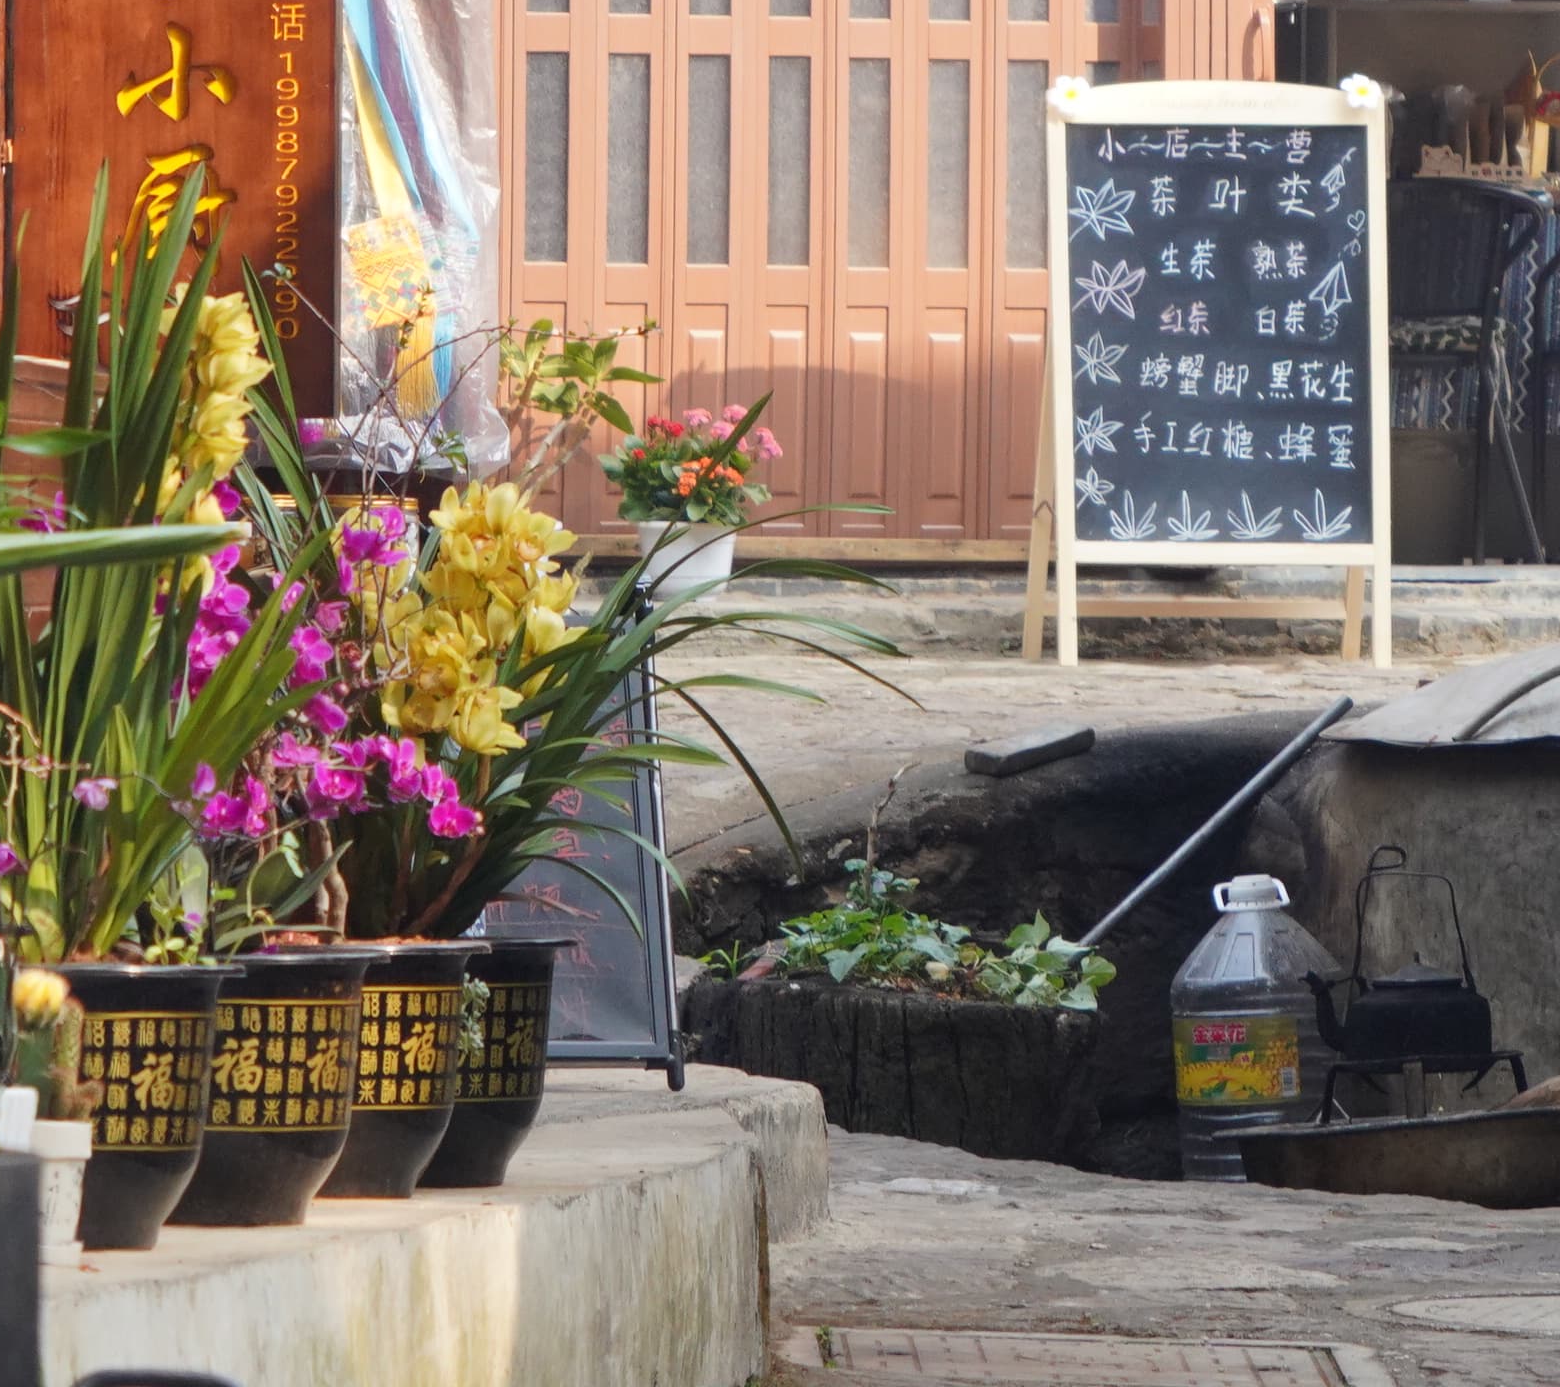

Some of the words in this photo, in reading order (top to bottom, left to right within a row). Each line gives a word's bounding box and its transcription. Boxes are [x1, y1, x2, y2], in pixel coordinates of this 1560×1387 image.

[211, 1037, 263, 1093] 福
[306, 1037, 339, 1093] 福
[401, 1021, 436, 1075] 福
[131, 1052, 175, 1111] 福
